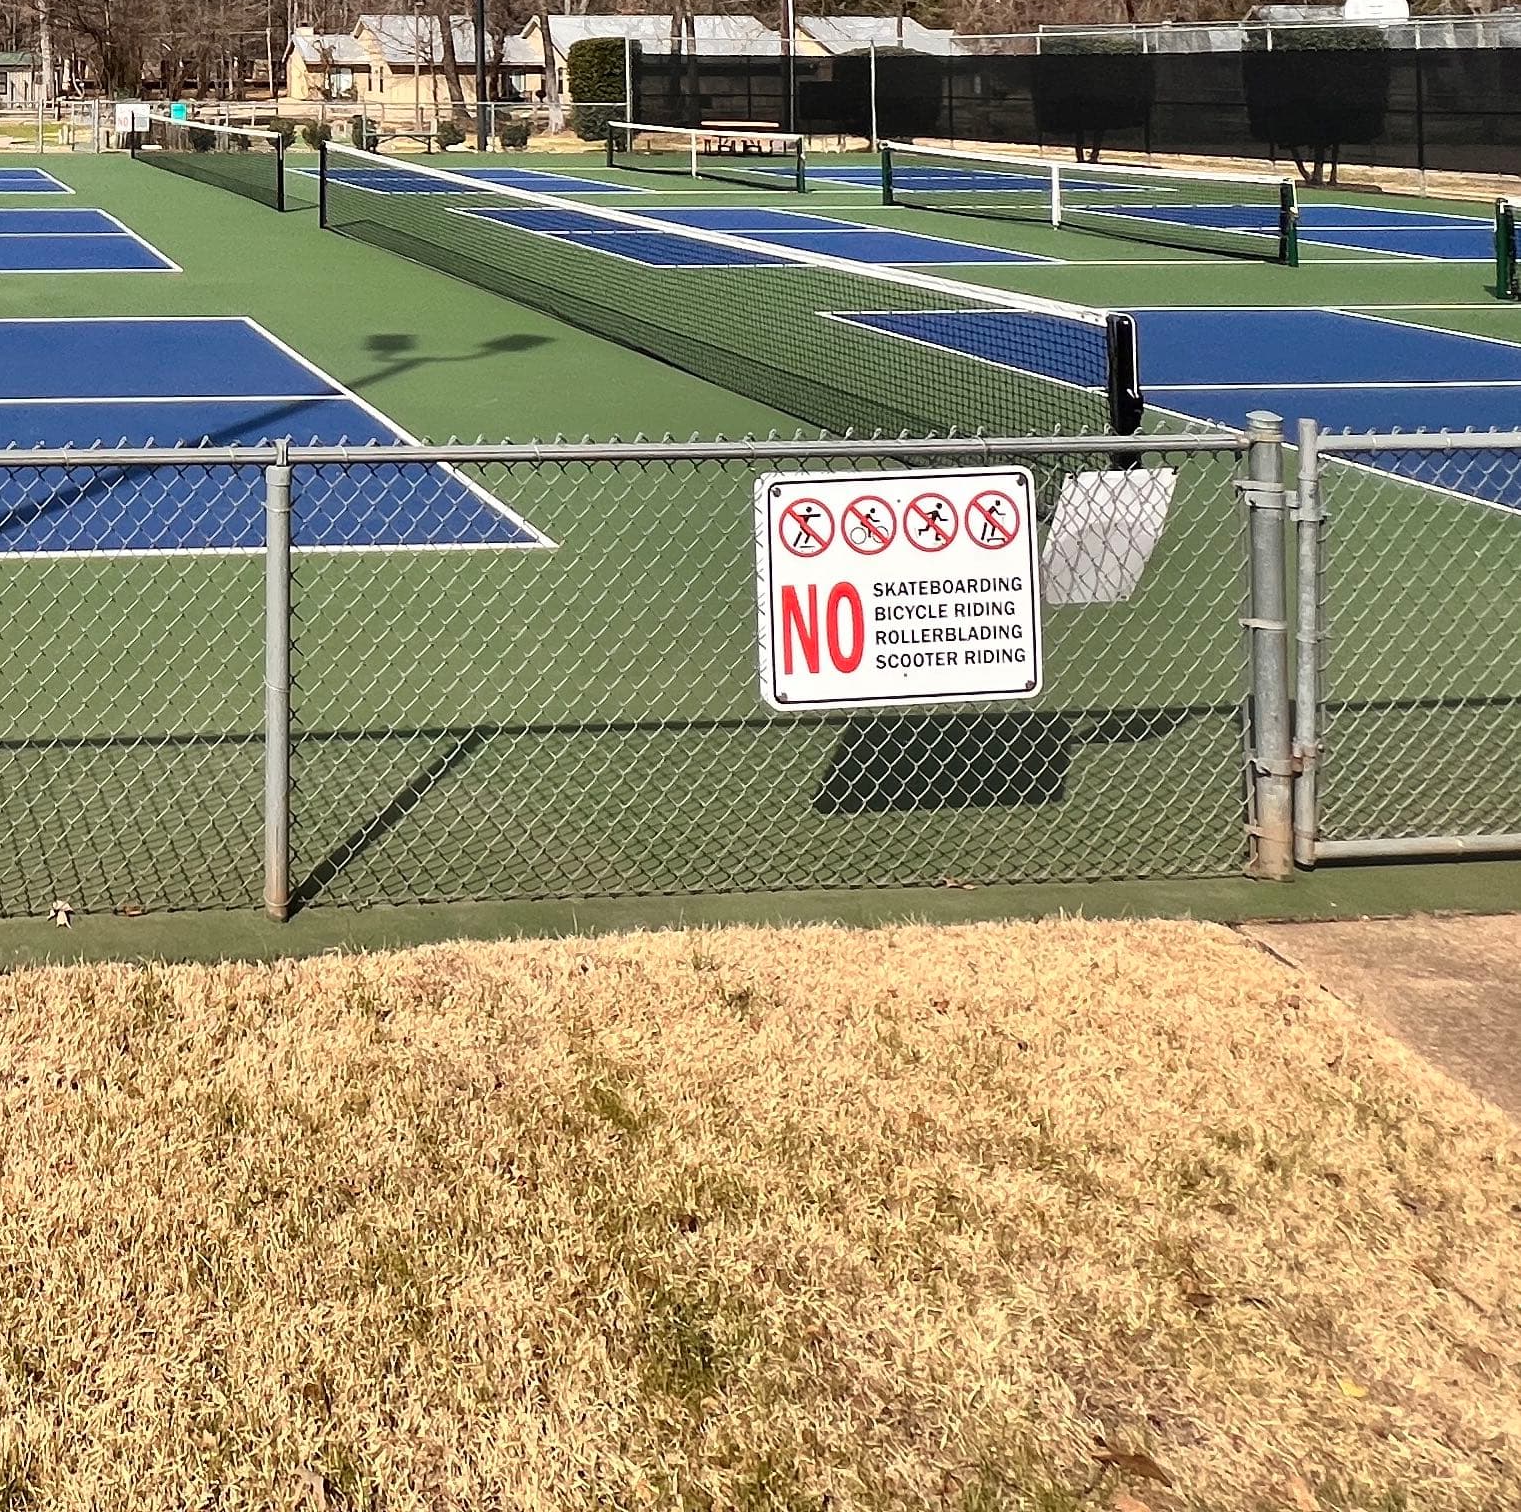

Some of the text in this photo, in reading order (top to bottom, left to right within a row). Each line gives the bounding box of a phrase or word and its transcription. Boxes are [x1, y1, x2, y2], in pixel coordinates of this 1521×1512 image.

[873, 577, 1023, 598] SKATEBOARDING
[875, 601, 1016, 621] BICYCLE RIDING
[781, 581, 865, 675] NO
[875, 624, 1023, 645] ROLLERBLADING
[876, 648, 1026, 670] SCOOTER RIDING
